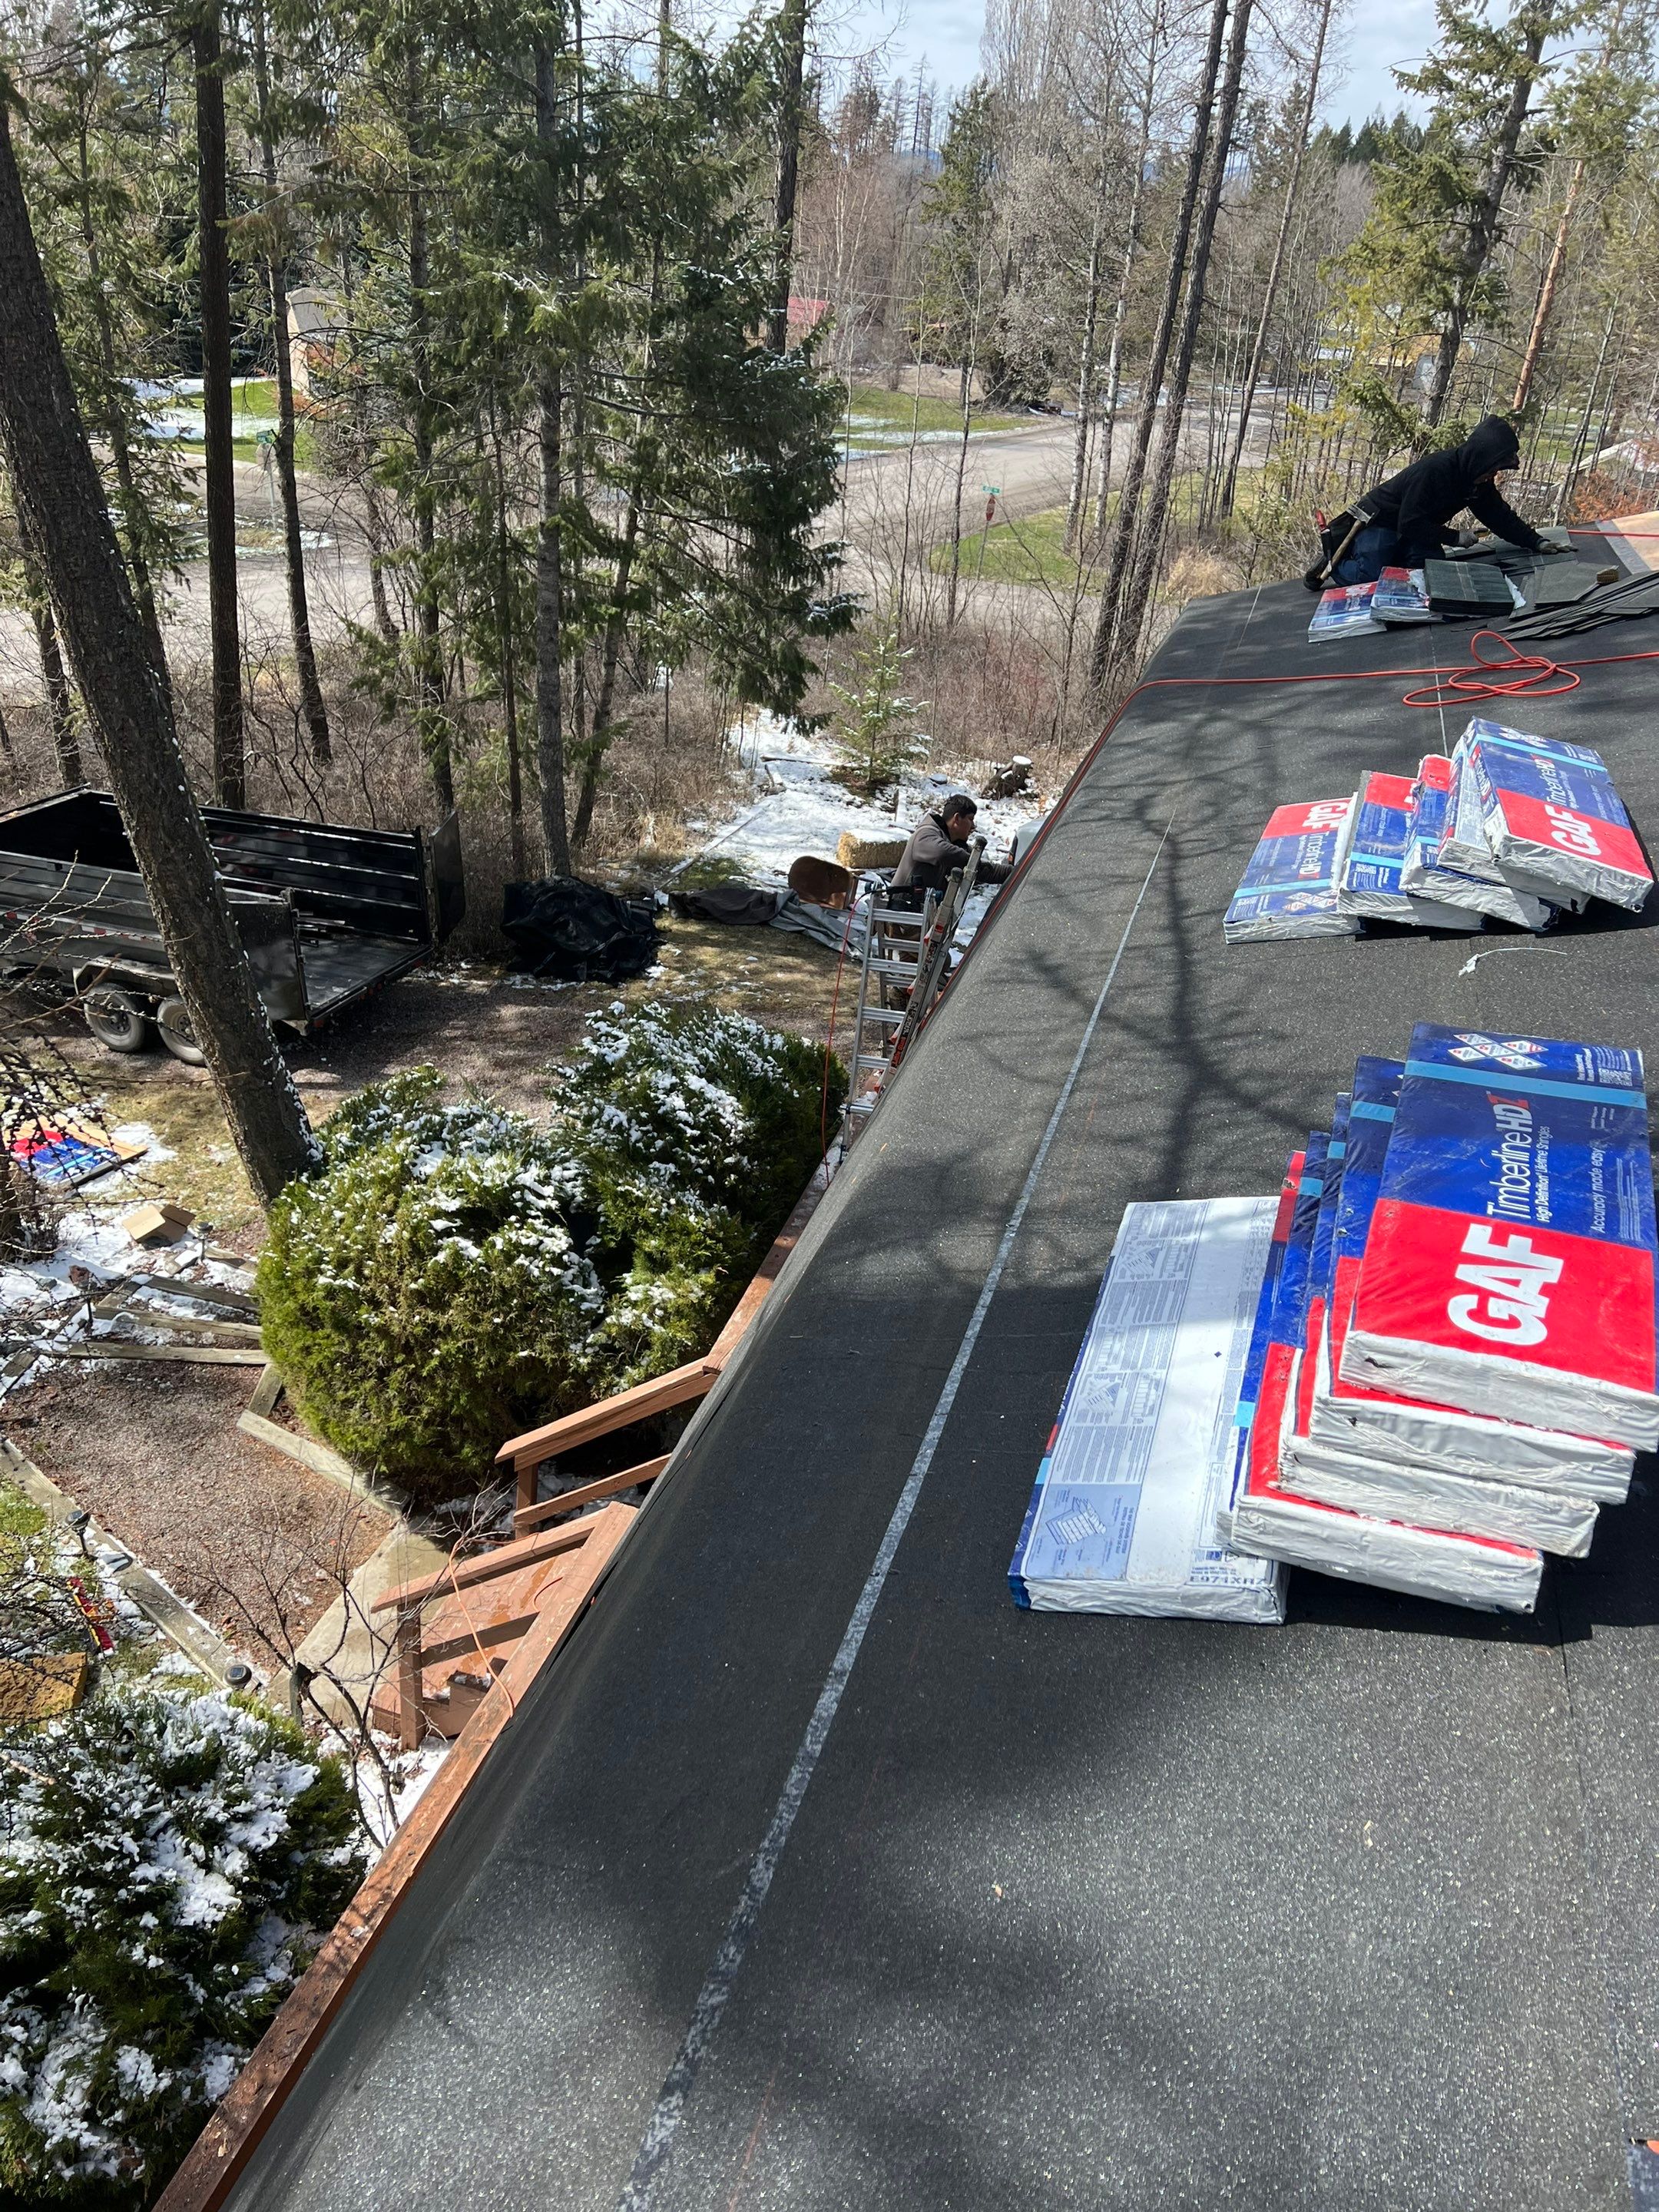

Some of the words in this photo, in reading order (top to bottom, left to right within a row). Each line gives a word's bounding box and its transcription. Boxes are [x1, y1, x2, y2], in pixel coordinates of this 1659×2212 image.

[1302, 802, 1349, 830] GAF
[1544, 803, 1602, 856] GAF
[1591, 1147, 1606, 1167] easy
[1588, 1167, 1604, 1192] made
[1536, 1206, 1553, 1223] High
[1590, 1191, 1607, 1234] Accuracy
[1446, 1223, 1565, 1346] GAF
